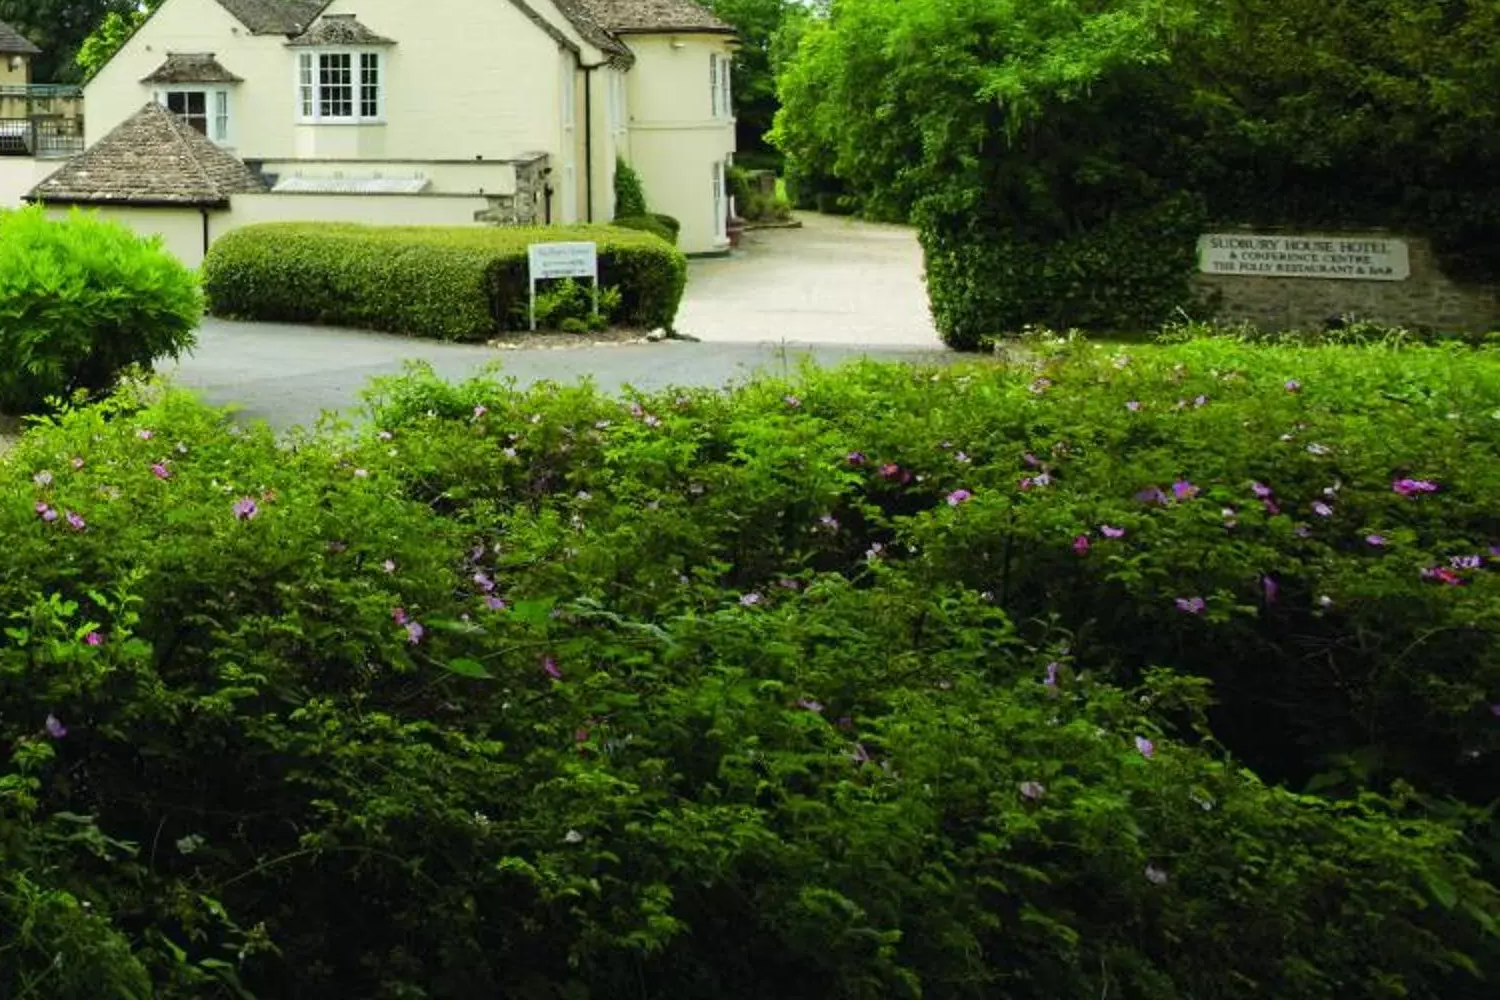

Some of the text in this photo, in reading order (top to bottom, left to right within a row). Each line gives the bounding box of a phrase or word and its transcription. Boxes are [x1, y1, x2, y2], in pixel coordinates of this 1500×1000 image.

[1210, 237, 1391, 254] SUDBURY HOUSE HOTEL
[1241, 251, 1319, 262] CONFERENCE
[1322, 254, 1370, 264] CENTRE
[1213, 261, 1235, 271] THE
[1276, 263, 1353, 274] RESTAURANT
